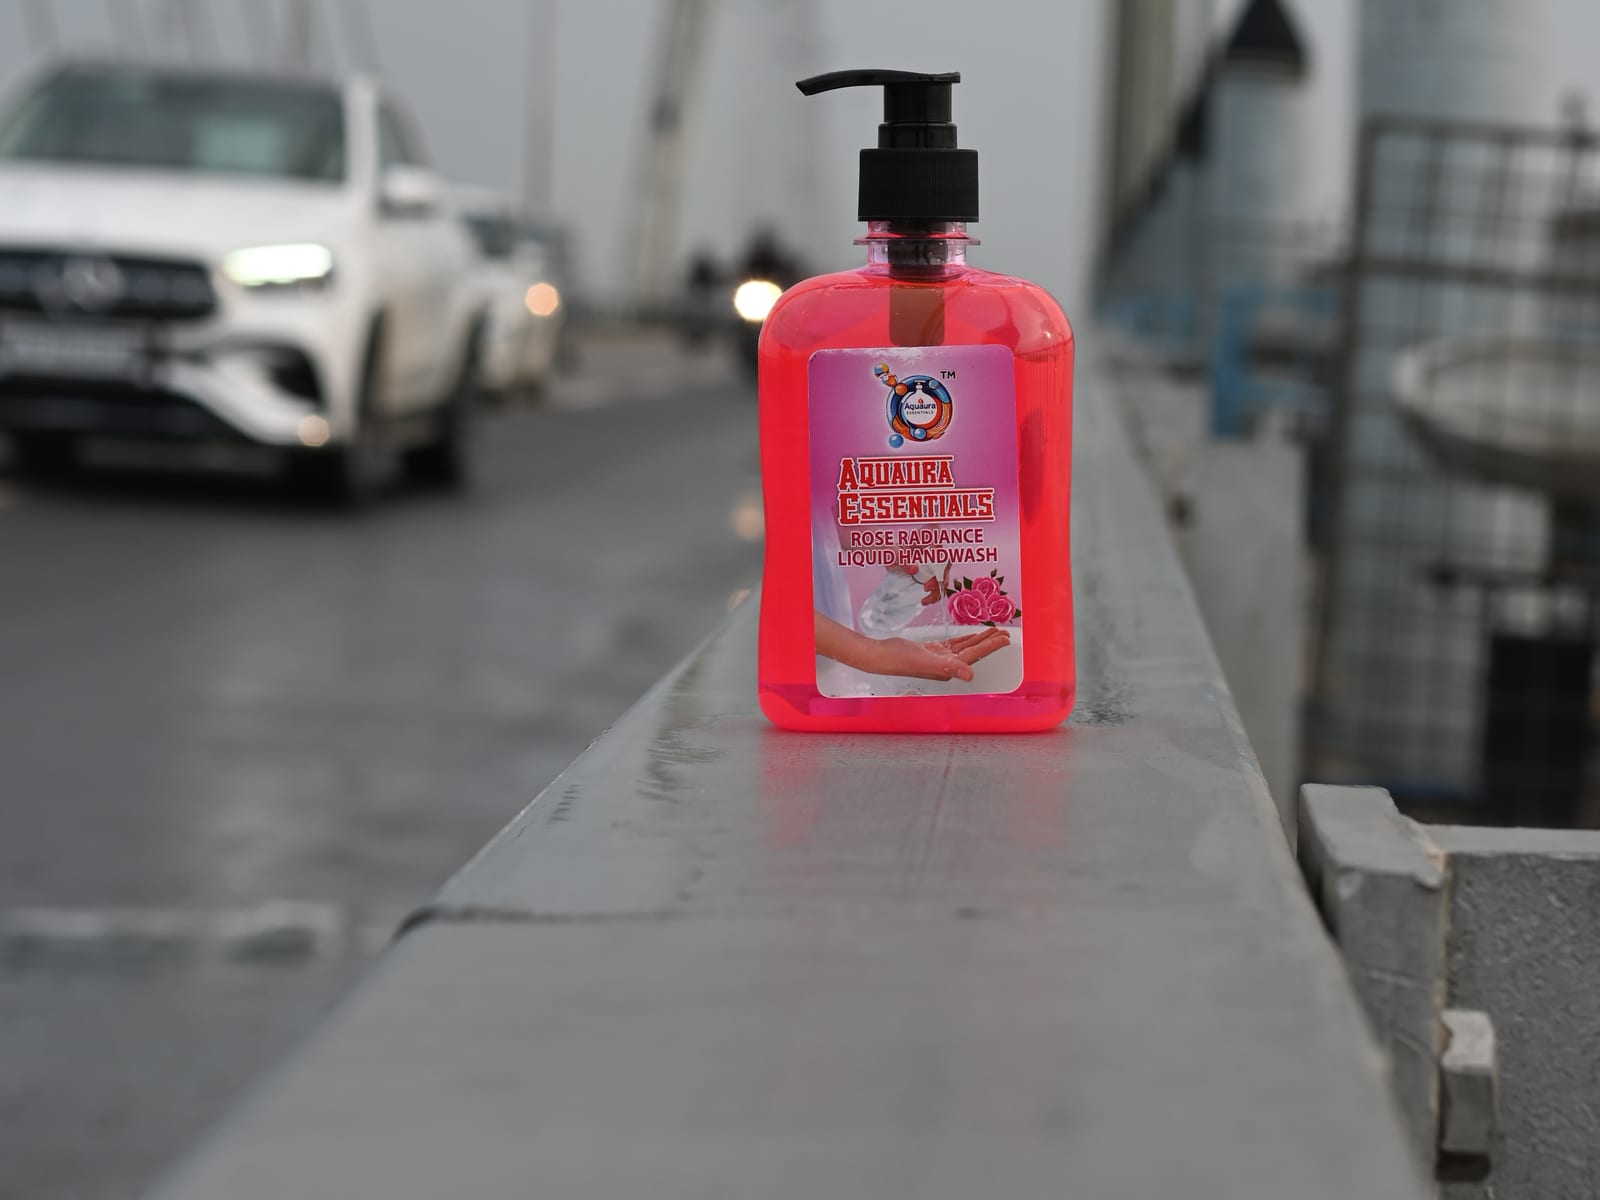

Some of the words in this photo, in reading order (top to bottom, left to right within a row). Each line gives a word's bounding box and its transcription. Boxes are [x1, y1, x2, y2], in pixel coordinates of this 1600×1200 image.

[940, 371, 956, 379] TM
[904, 402, 936, 410] Aquaura
[838, 457, 953, 490] AQUAURA
[839, 490, 994, 524] ESSENTIALS
[851, 531, 894, 546] ROSE
[898, 529, 984, 545] RADIANCE
[838, 550, 895, 567] LIQUID
[900, 547, 998, 564] HANDWASH
